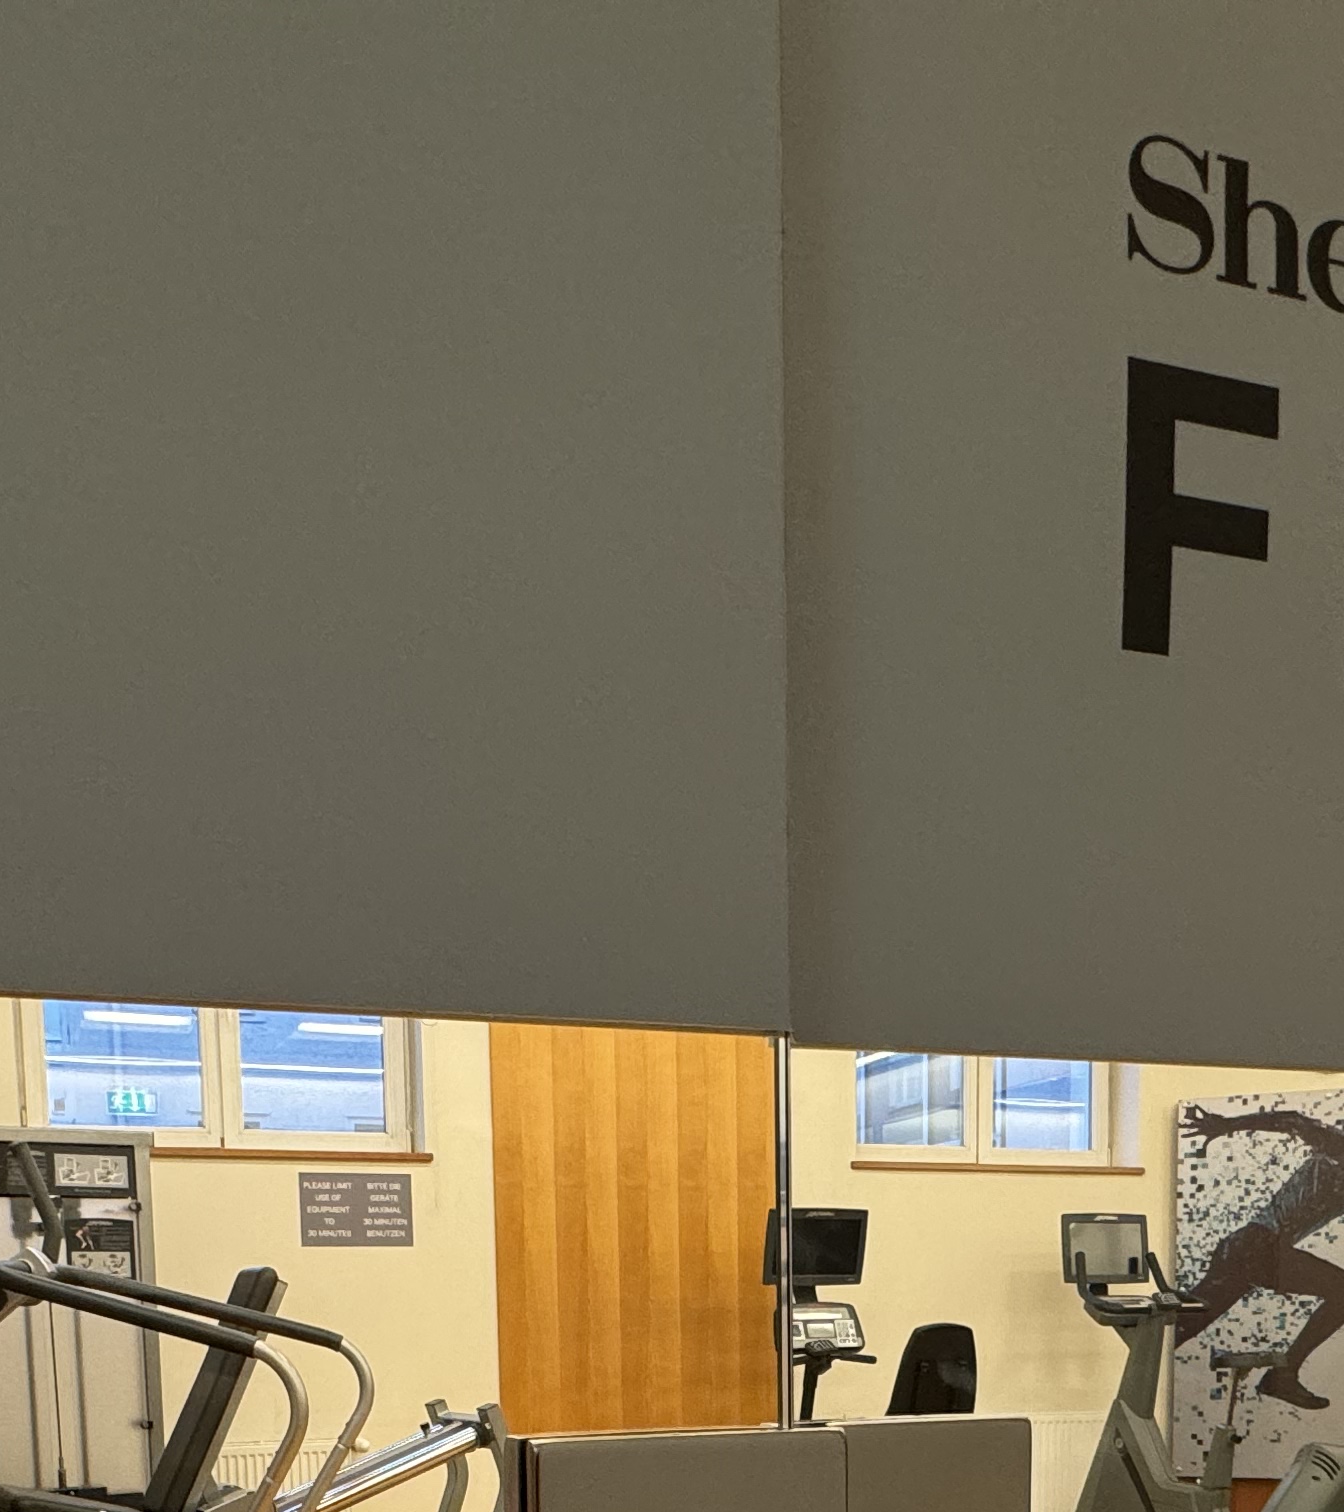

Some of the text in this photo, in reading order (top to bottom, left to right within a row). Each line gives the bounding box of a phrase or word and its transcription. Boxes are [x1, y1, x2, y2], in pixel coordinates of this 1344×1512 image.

[303, 1182, 331, 1190] PLEASE
[331, 1194, 342, 1202] OF
[306, 1206, 350, 1214] EQUIPMENT
[367, 1206, 401, 1214] MAXIMAL
